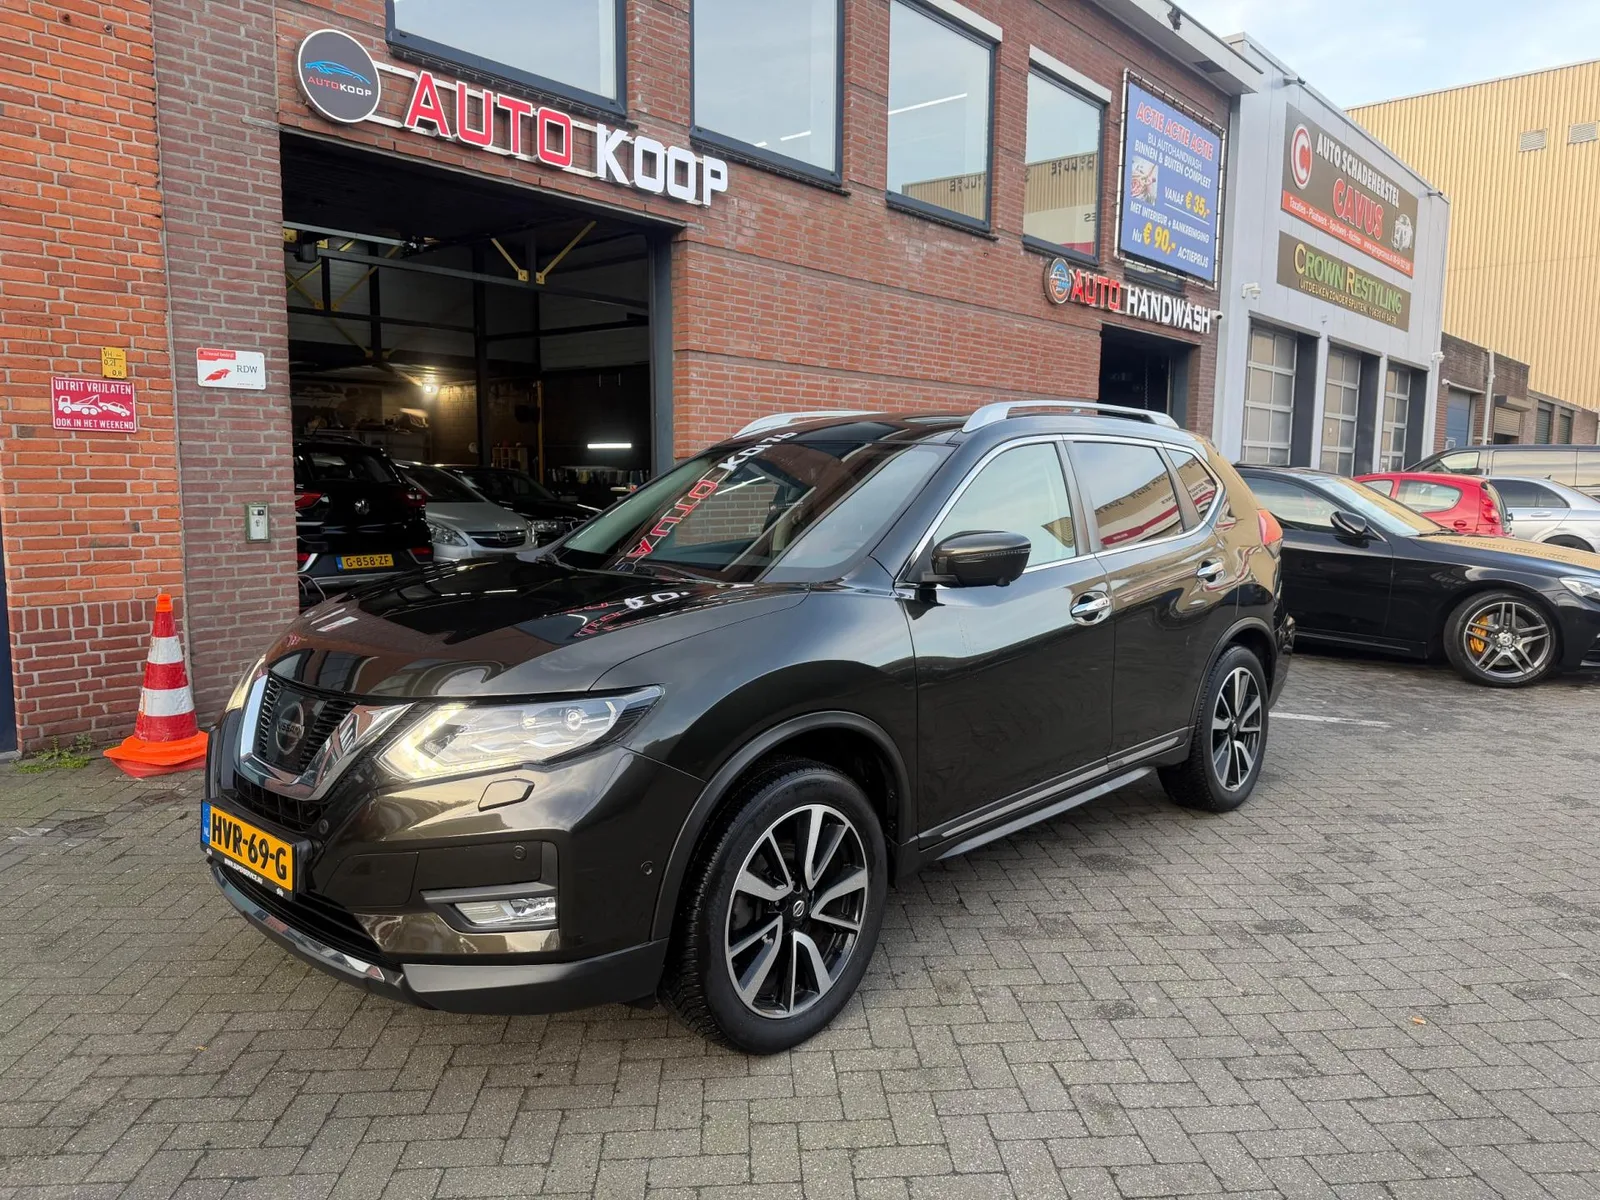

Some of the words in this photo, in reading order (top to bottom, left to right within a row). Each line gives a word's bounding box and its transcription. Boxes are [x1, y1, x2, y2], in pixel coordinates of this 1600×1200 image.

[402, 70, 574, 168] AUTO
[597, 122, 729, 207] KOOP
[1136, 102, 1164, 133] ACTIE
[1164, 119, 1190, 147] ACTIE
[1190, 133, 1213, 160] ACTIE
[1134, 140, 1158, 161] BINNEN
[1164, 155, 1183, 174] BUITEN
[1184, 163, 1211, 189] COMPLEET
[1157, 136, 1202, 171] AUTOHANDWASH
[1316, 133, 1341, 168] AUTO
[1341, 149, 1400, 208] SCHADEHERSTEL
[1130, 200, 1141, 215] MET
[1141, 207, 1168, 225] INTERIEUR
[1164, 186, 1184, 205] VANAF
[1333, 178, 1384, 240] CAVUS
[1177, 246, 1209, 268] ACTIEPRIJS
[1070, 268, 1121, 311] AUTO
[1126, 285, 1212, 334] HANDWASH
[55, 380, 85, 392] UITRIT
[86, 382, 132, 395] VRIJLATEN
[236, 364, 258, 374] RDW
[56, 417, 72, 427] OOK
[73, 418, 82, 427] IN
[83, 418, 98, 428] HET
[99, 419, 134, 430] WEEKEND
[211, 812, 287, 881] HVR-69-G
